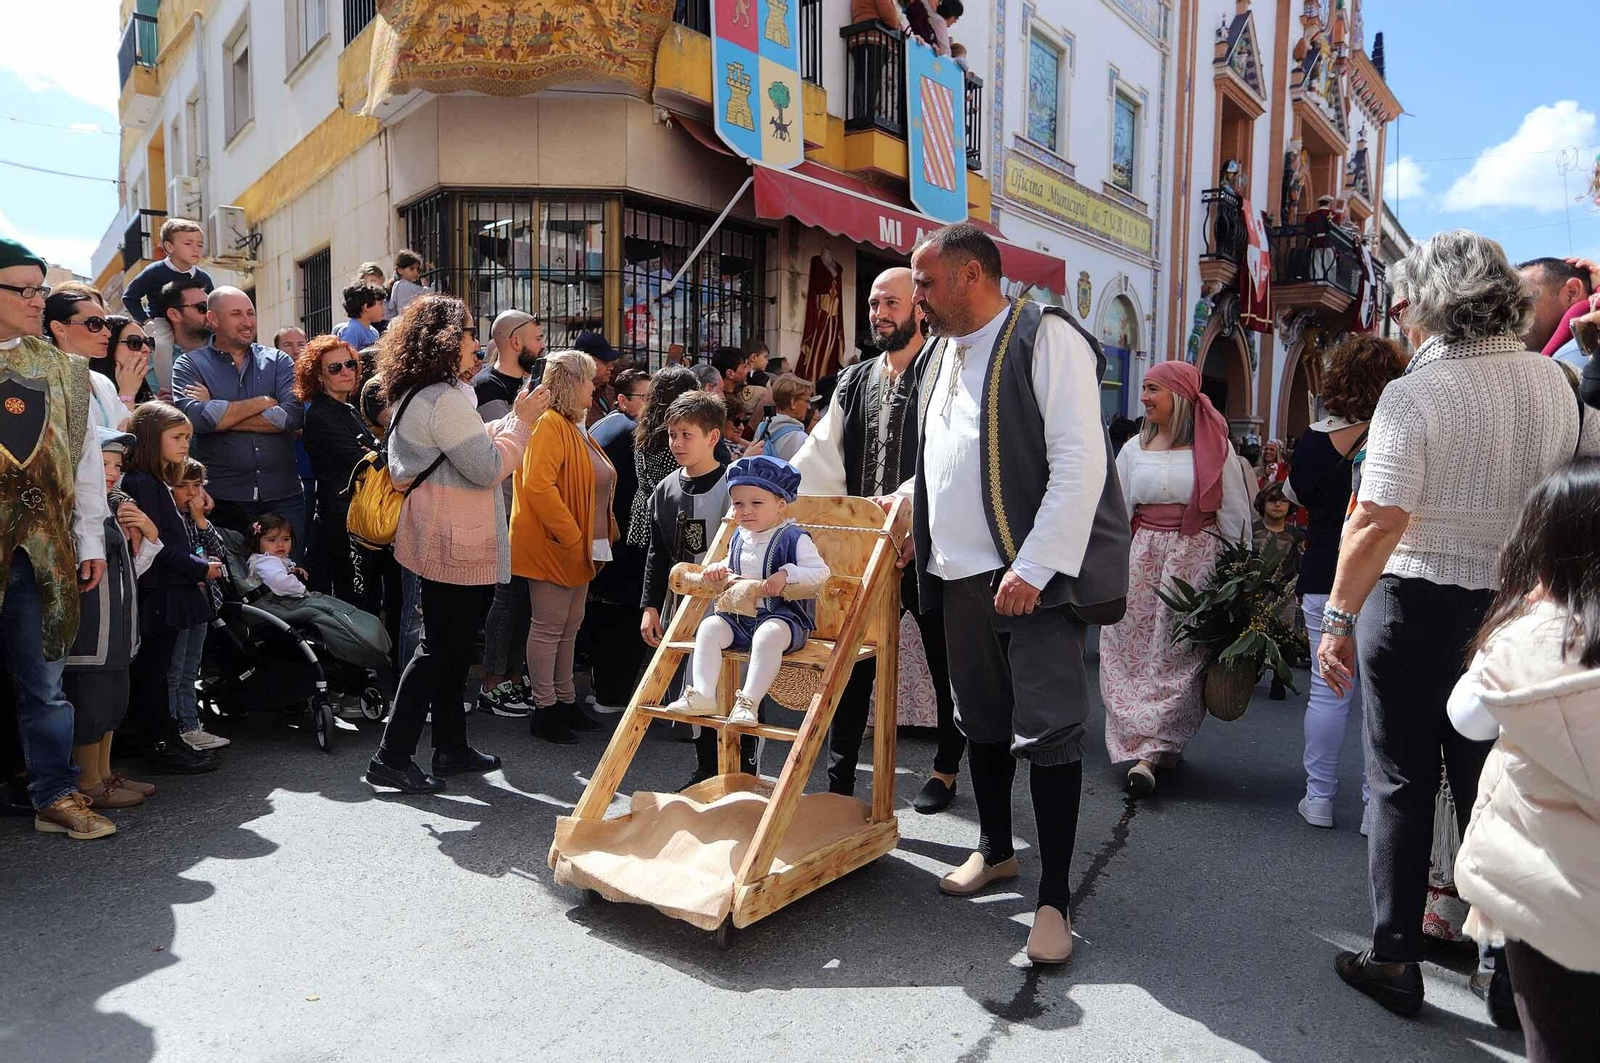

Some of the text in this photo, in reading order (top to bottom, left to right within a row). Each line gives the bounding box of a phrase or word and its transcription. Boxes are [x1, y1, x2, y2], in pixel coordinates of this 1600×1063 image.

[1011, 168, 1146, 240] Oficina Municipal de TURISMO
[879, 215, 902, 246] MI
